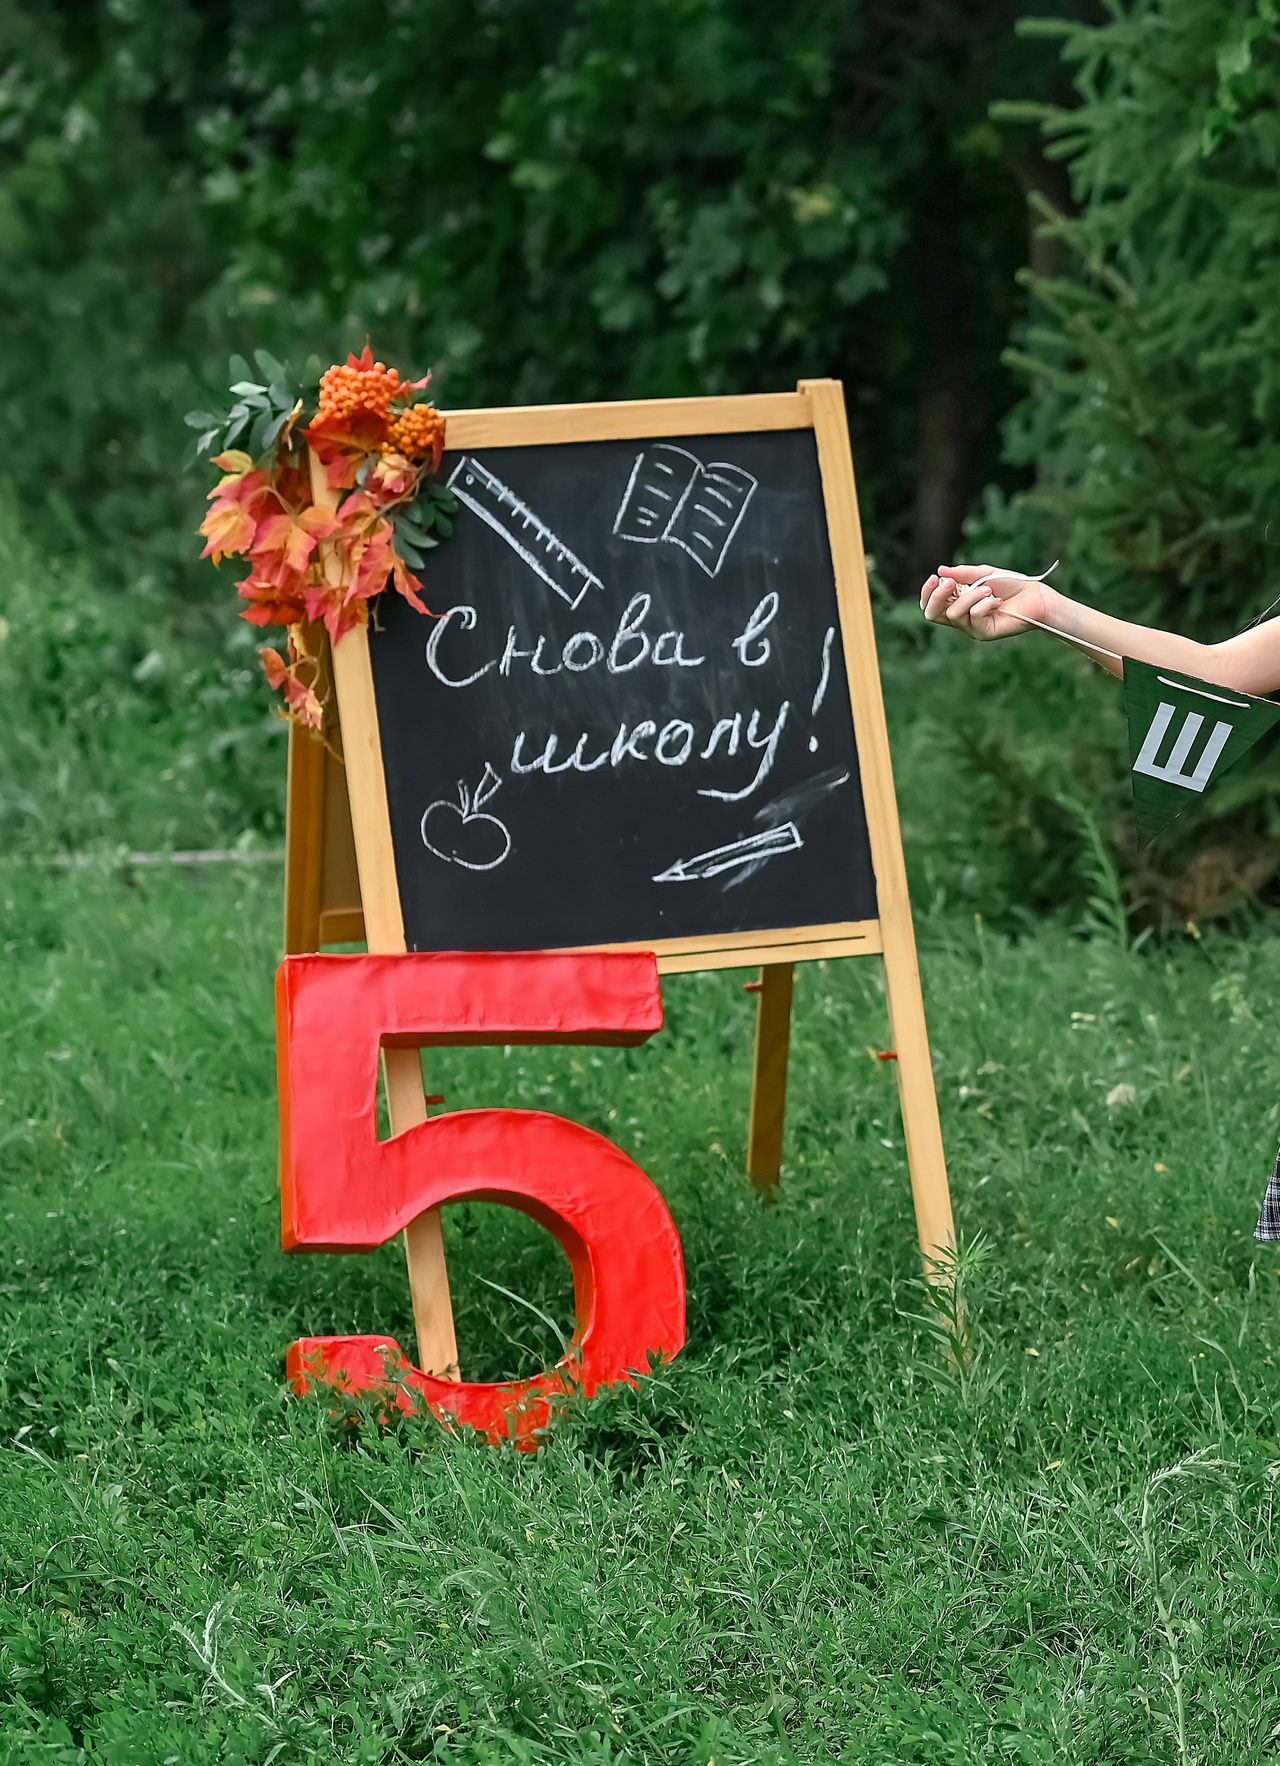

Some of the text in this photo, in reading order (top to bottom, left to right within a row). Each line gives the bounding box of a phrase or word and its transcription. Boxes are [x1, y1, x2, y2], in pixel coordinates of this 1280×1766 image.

[426, 591, 779, 688] Снова в
[510, 626, 835, 802] школу!
[276, 951, 687, 1453] 5
